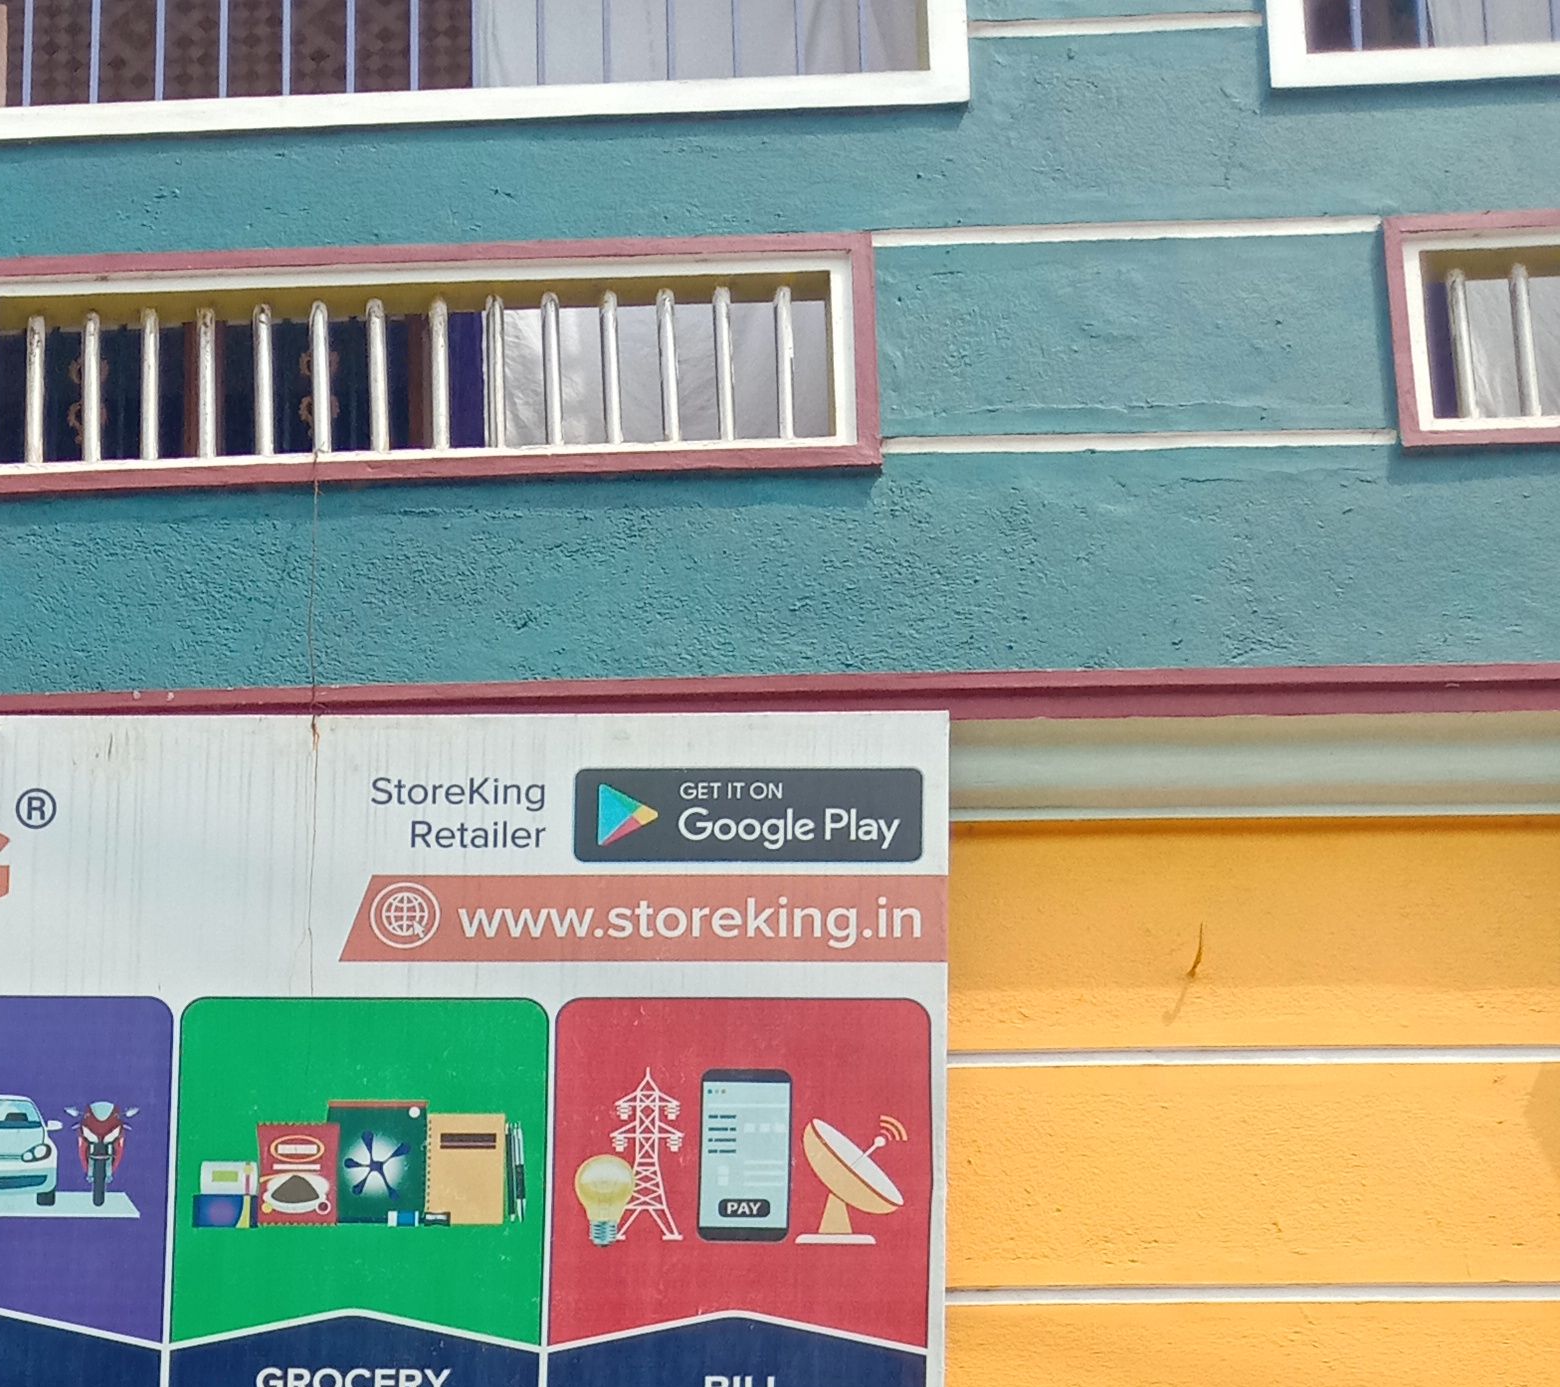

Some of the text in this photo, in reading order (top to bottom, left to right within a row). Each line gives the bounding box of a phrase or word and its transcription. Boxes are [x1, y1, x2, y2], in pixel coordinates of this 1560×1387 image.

[371, 777, 545, 812] StoreKing
[679, 781, 783, 800] GET IT ON
[410, 820, 546, 849] Retailer
[677, 806, 901, 850] Google Play
[458, 896, 922, 949] www.storeking.in
[726, 1201, 762, 1215] PAY
